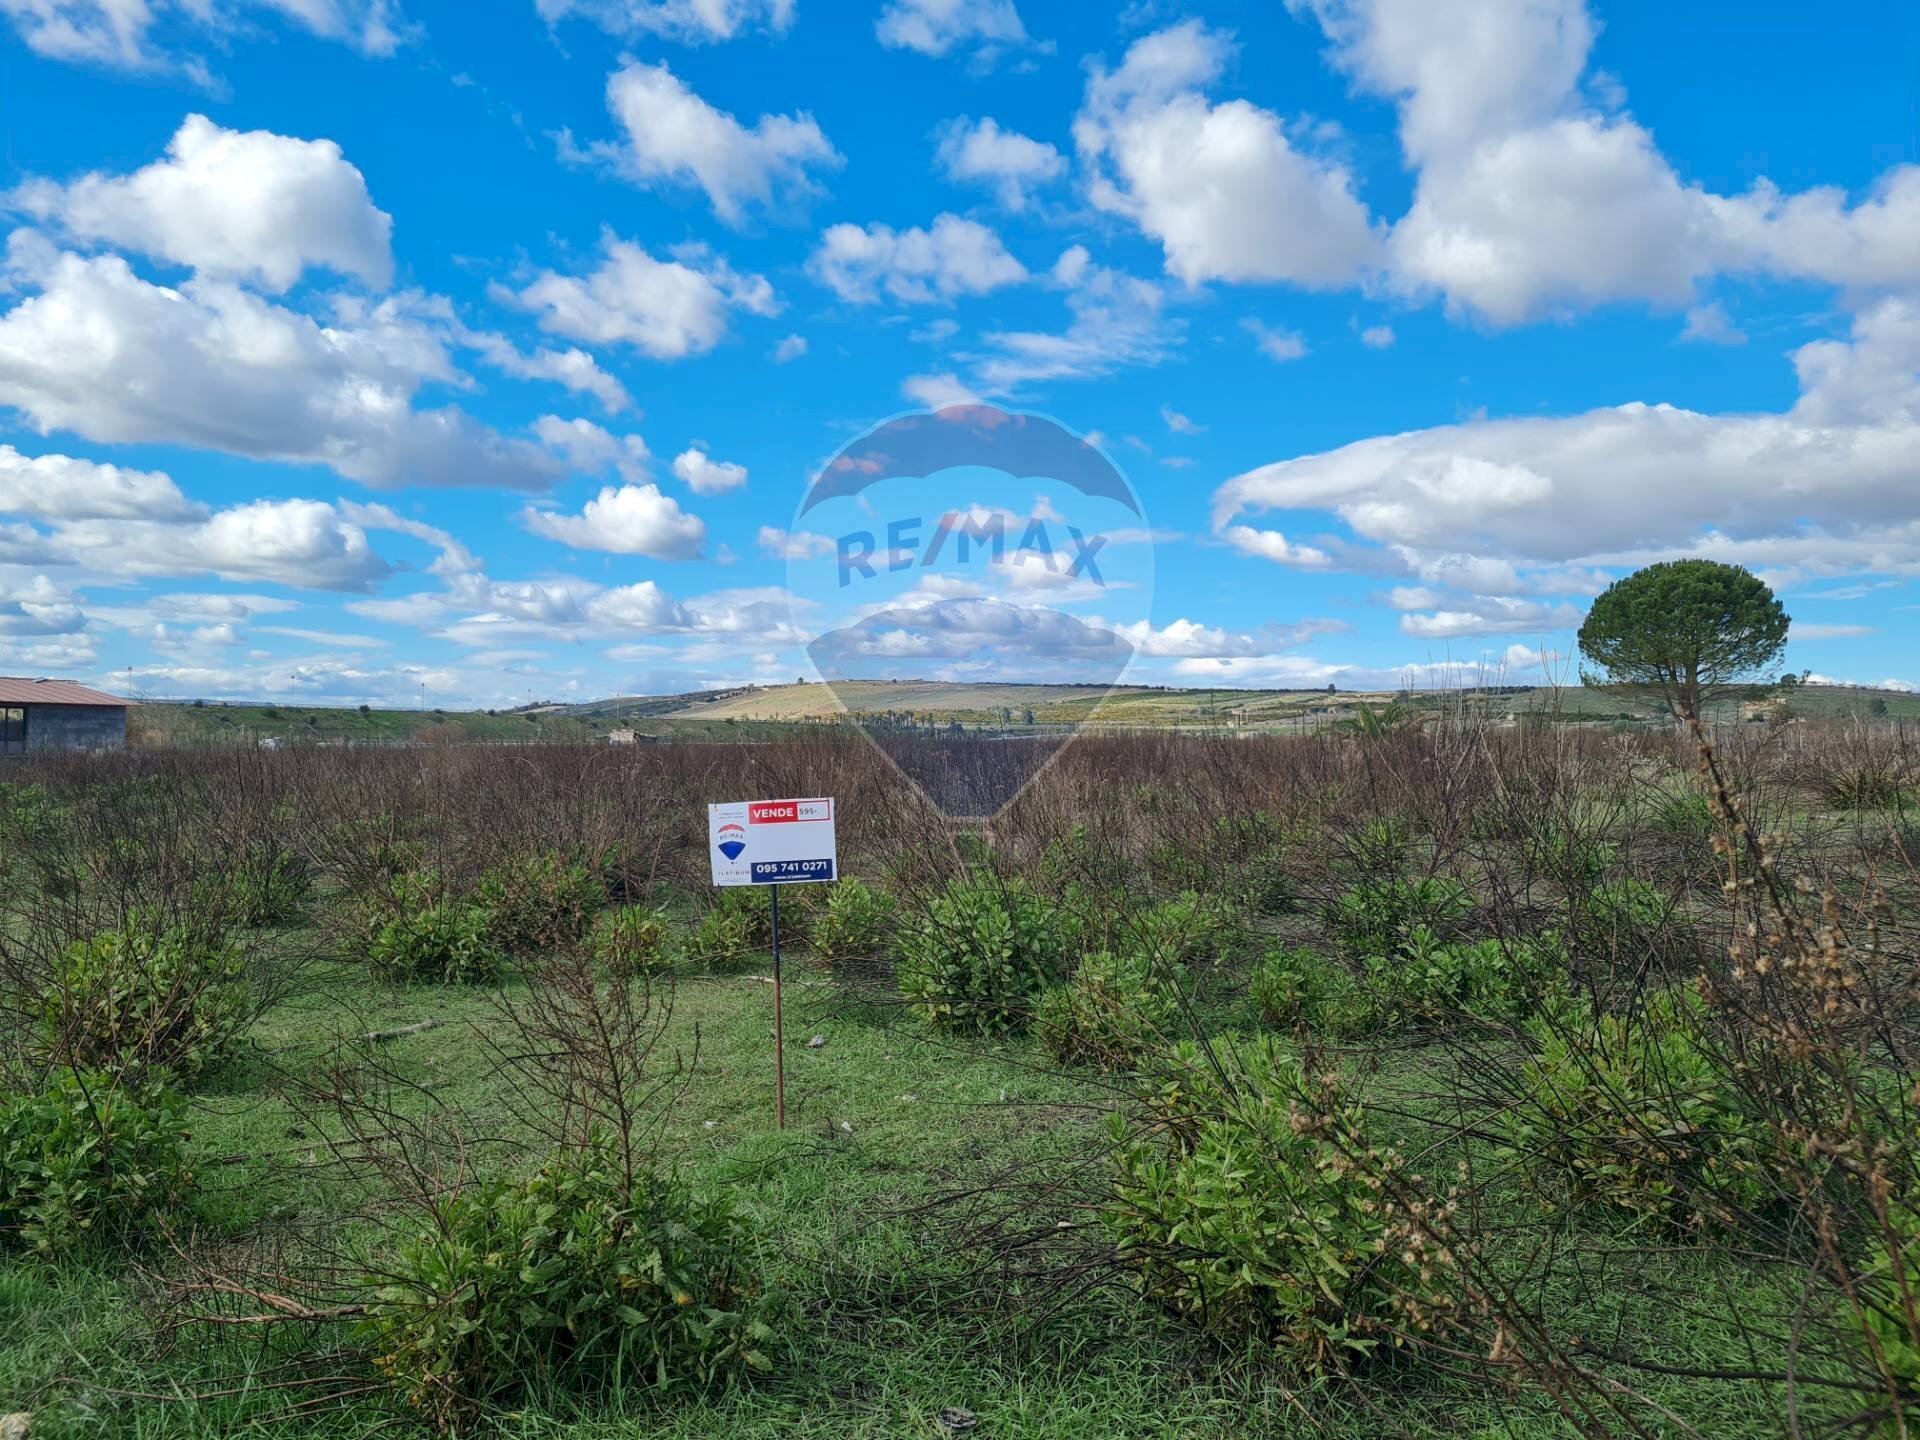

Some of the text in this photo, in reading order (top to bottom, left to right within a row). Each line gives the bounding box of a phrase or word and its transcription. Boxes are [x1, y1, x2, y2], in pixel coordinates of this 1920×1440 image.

[752, 807, 794, 819] VENDE
[756, 861, 827, 874] 095 741 0271
